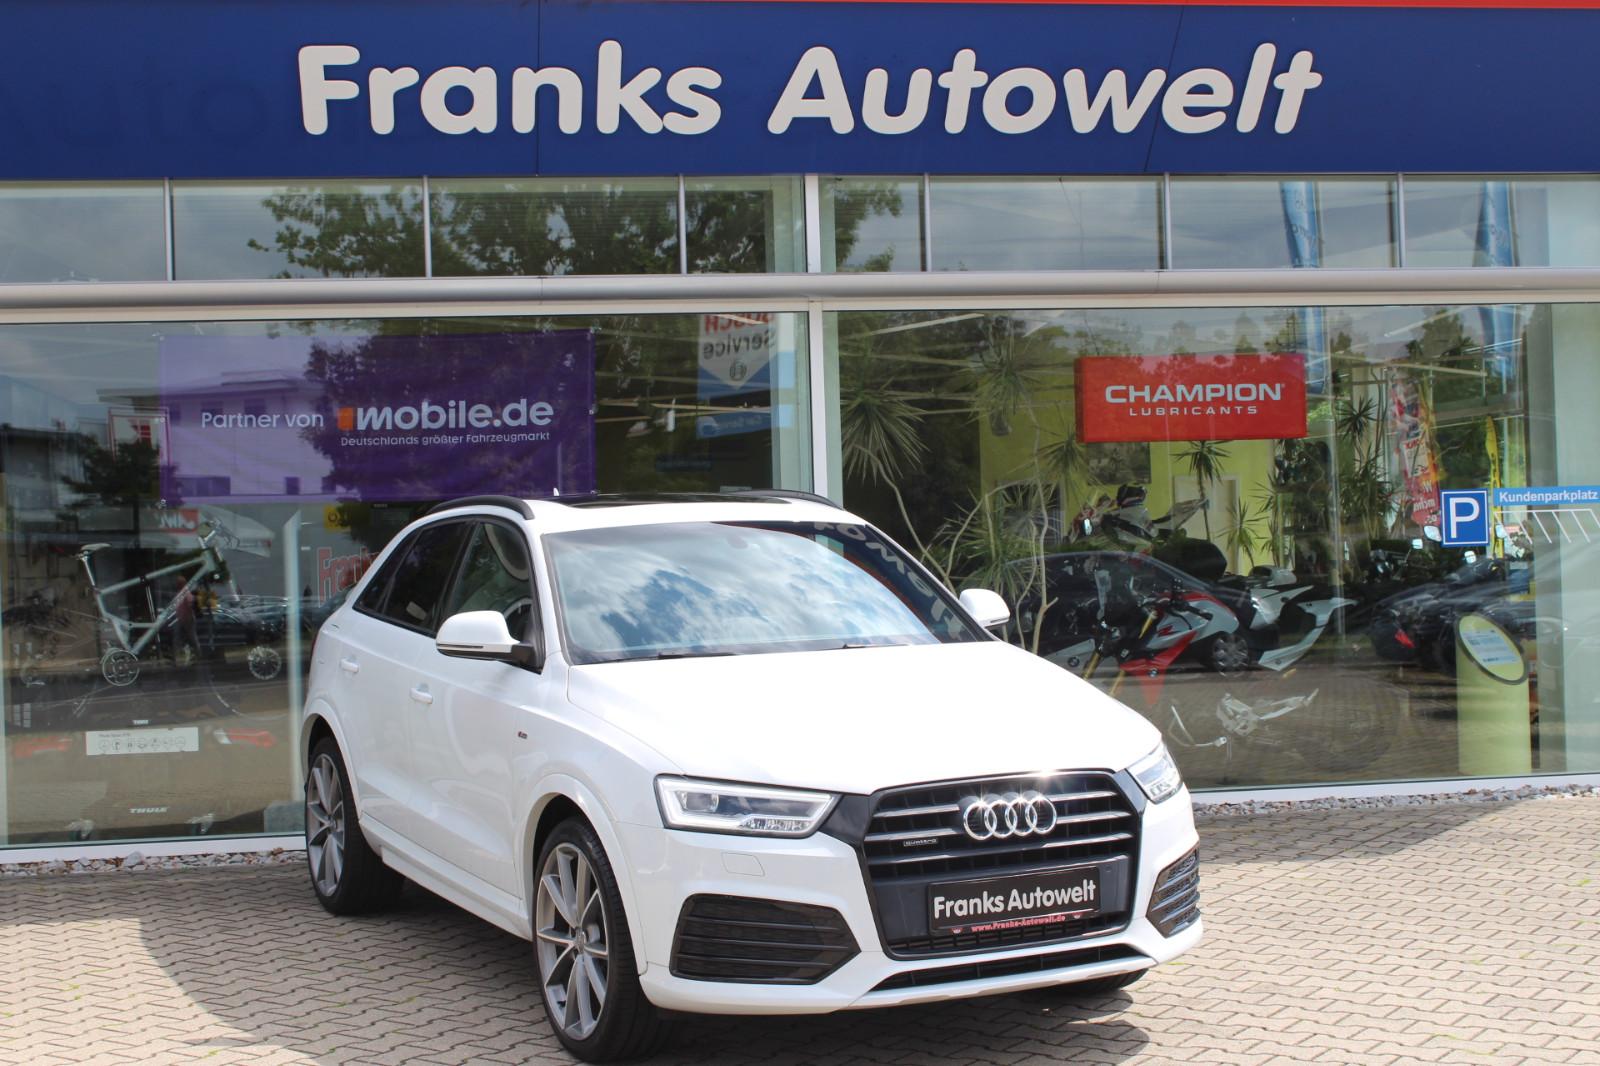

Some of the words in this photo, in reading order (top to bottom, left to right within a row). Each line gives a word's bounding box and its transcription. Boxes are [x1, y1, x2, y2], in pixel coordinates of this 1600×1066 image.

[297, 40, 723, 136] Franks
[767, 42, 1323, 135] Autowelt
[1105, 383, 1281, 403] CHAMPION
[201, 412, 280, 428] Partner
[285, 413, 324, 428] von
[357, 398, 554, 431] mobile.de
[1130, 406, 1258, 416] LUBRICANTS
[341, 434, 419, 447] Deutschlands
[422, 434, 463, 445] größter
[466, 431, 550, 443] Fahrzeugmarkt
[1499, 490, 1598, 503] Kundenparkplatz
[1449, 497, 1480, 538] P
[934, 891, 1004, 919] Franks
[1008, 879, 1096, 911] Autowelt
